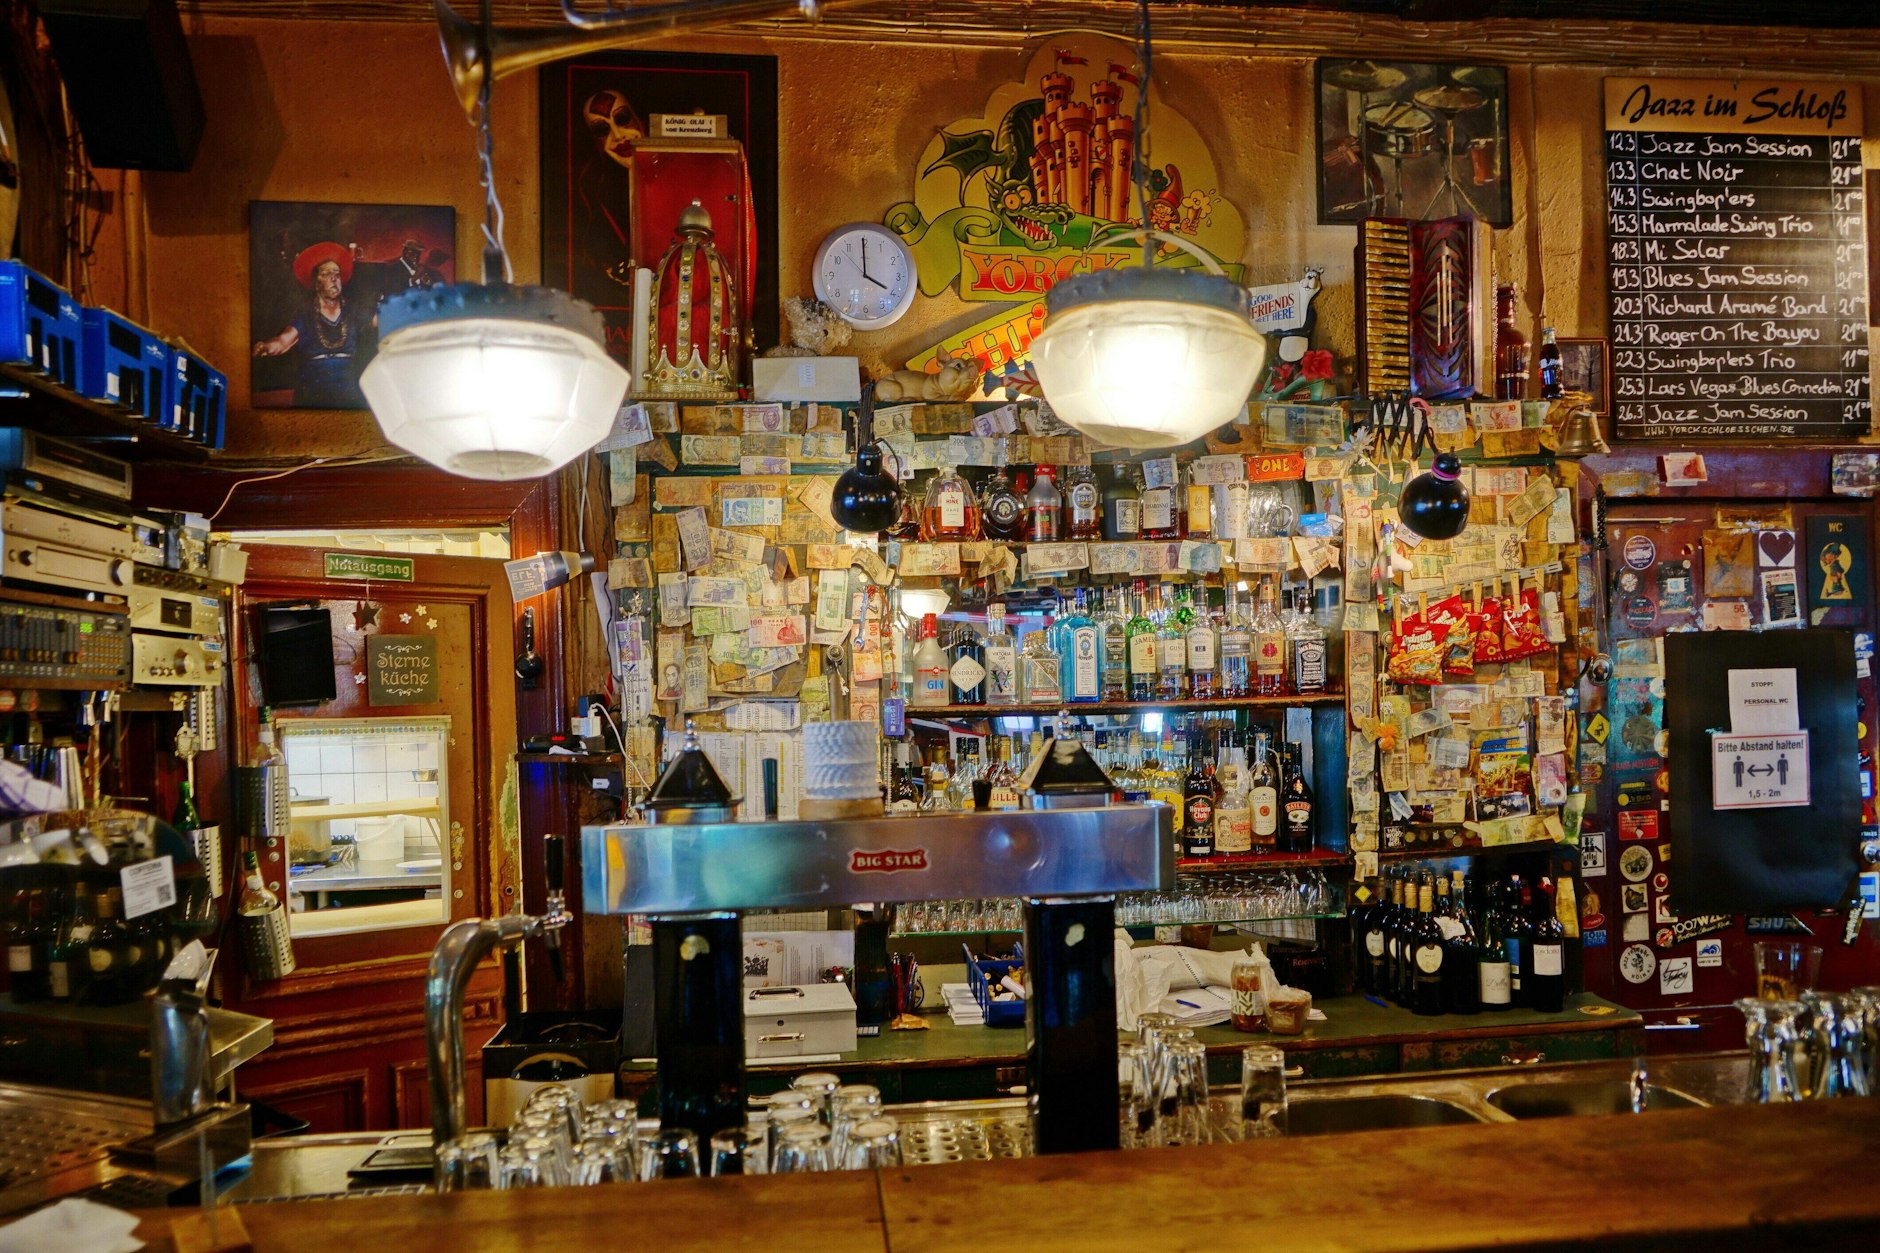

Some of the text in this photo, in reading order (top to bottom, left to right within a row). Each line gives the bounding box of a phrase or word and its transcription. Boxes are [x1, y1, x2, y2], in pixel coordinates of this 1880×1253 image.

[1621, 84, 1847, 129] Jazz im Schloß
[1641, 134, 1695, 154] Jazz
[1699, 136, 1741, 155] Jam
[1745, 136, 1812, 158] Session
[1609, 161, 1637, 180] 13.3
[1641, 162, 1692, 180] Chat
[1697, 161, 1744, 181] Noir
[1611, 187, 1637, 207] 14.3
[1611, 213, 1638, 233] 15.3
[1642, 214, 1728, 234] Marmalade
[1730, 215, 1776, 238] Swing
[1778, 215, 1814, 234] Trio
[1646, 240, 1667, 262] Mi
[834, 256, 842, 265] 10
[890, 257, 897, 266] 2
[828, 271, 835, 281] 9
[895, 272, 902, 281] 3
[1613, 267, 1640, 289] 19.3
[1643, 266, 1693, 288] Blues
[1697, 266, 1739, 289] Jam
[1741, 267, 1809, 287] Session
[834, 289, 841, 298] 8
[890, 289, 896, 297] 4
[1250, 294, 1273, 307] GOOD
[863, 305, 869, 314] 6
[1250, 293, 1295, 319] FRIENDS
[1644, 294, 1715, 316] Richard
[1719, 294, 1777, 315] Aramé
[1782, 295, 1828, 317] Band
[1272, 307, 1295, 321] HERE
[1615, 323, 1643, 344] 21.3
[1644, 323, 1699, 348] Roger
[1701, 326, 1725, 341] On
[1728, 322, 1759, 342] The
[1761, 321, 1820, 346] Bayou
[1647, 350, 1754, 374] Swingbop'ers
[1758, 349, 1796, 369] Trio
[1617, 377, 1645, 396] 25.3
[1648, 377, 1686, 395] Lars
[1739, 375, 1780, 396] Blues
[1782, 378, 1842, 395] Connection
[1618, 404, 1643, 420] 26.3
[1648, 404, 1699, 424] Jazz
[1703, 402, 1745, 422] Jam
[1747, 404, 1808, 420] Session
[1261, 457, 1290, 473] ONE
[1828, 522, 1843, 532] WC
[329, 558, 410, 577] Notausgang
[377, 652, 431, 669] Sterne
[379, 670, 430, 686] küche
[927, 680, 945, 690] GIN
[1718, 739, 1804, 753] Bitte Abstand halten!
[1749, 790, 1761, 799] 1,5
[1768, 788, 1781, 798] 2m
[1194, 811, 1207, 819] Club
[1285, 802, 1311, 812] BAILEYS
[857, 855, 921, 867] BIG STAR
